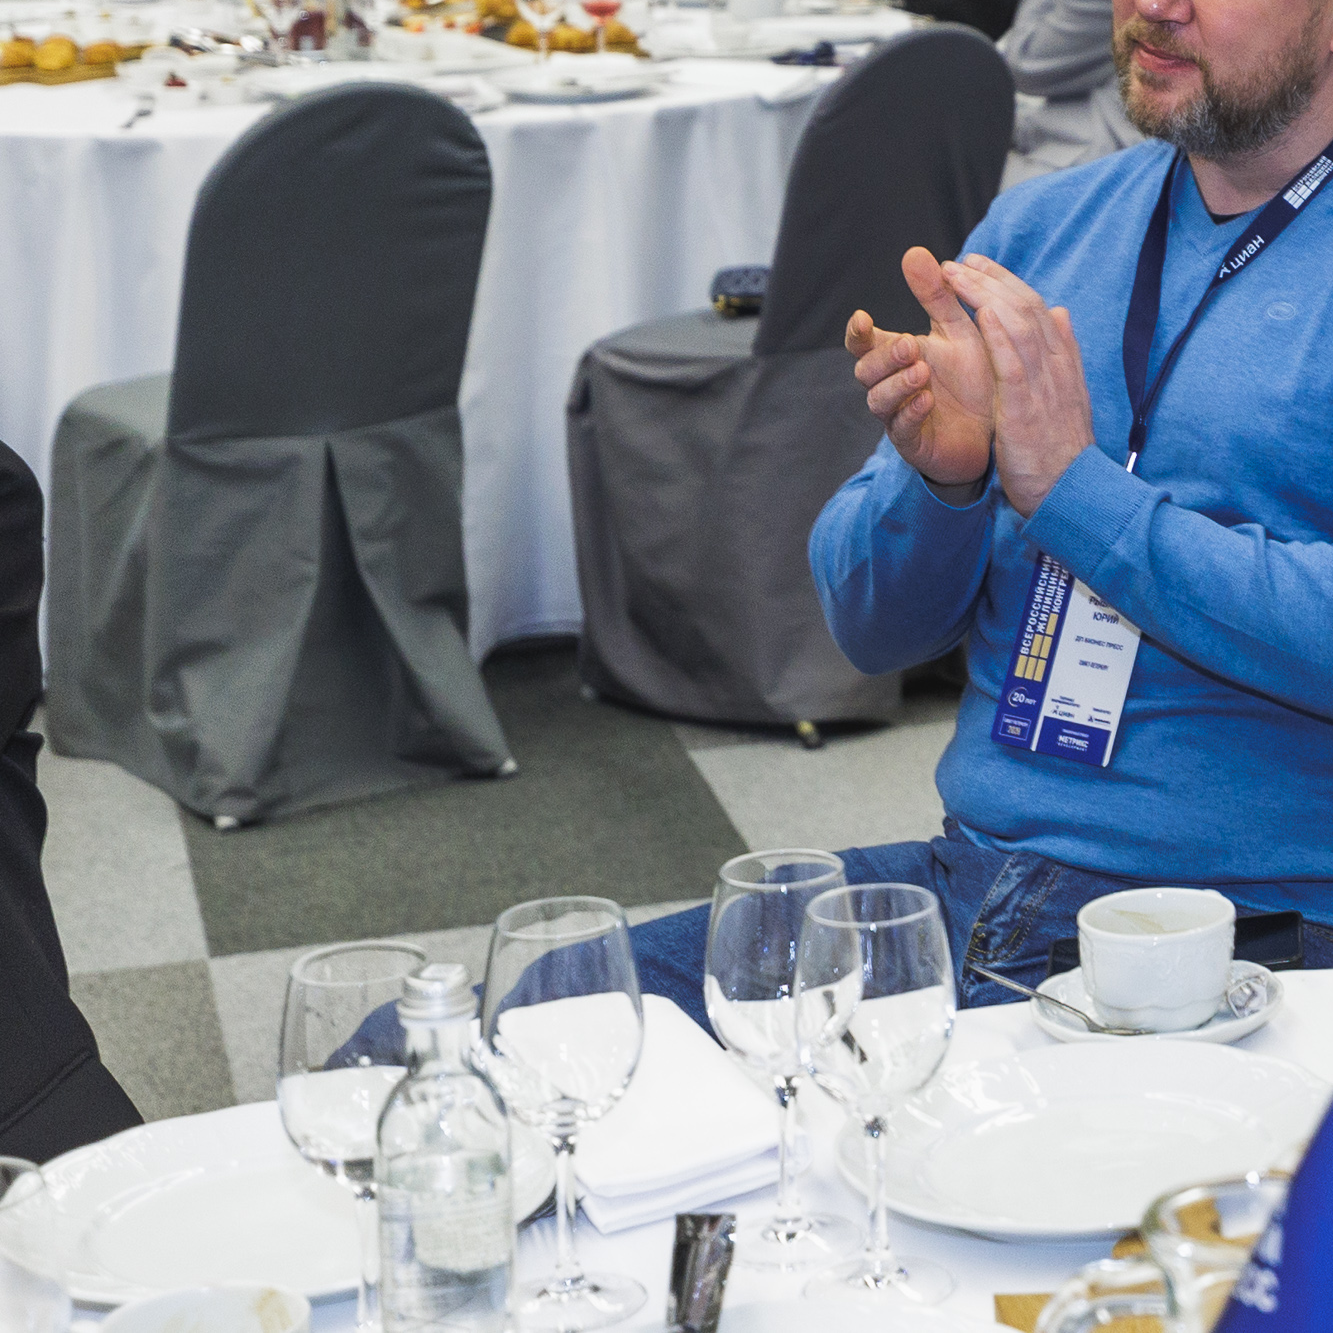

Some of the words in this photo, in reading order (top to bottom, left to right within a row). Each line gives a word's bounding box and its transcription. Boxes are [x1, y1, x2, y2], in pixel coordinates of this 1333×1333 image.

[1230, 235, 1265, 270] циан
[1020, 555, 1052, 655] ВСЕРОССИЙСКИЙ
[1093, 611, 1120, 624] ЮРИЙ
